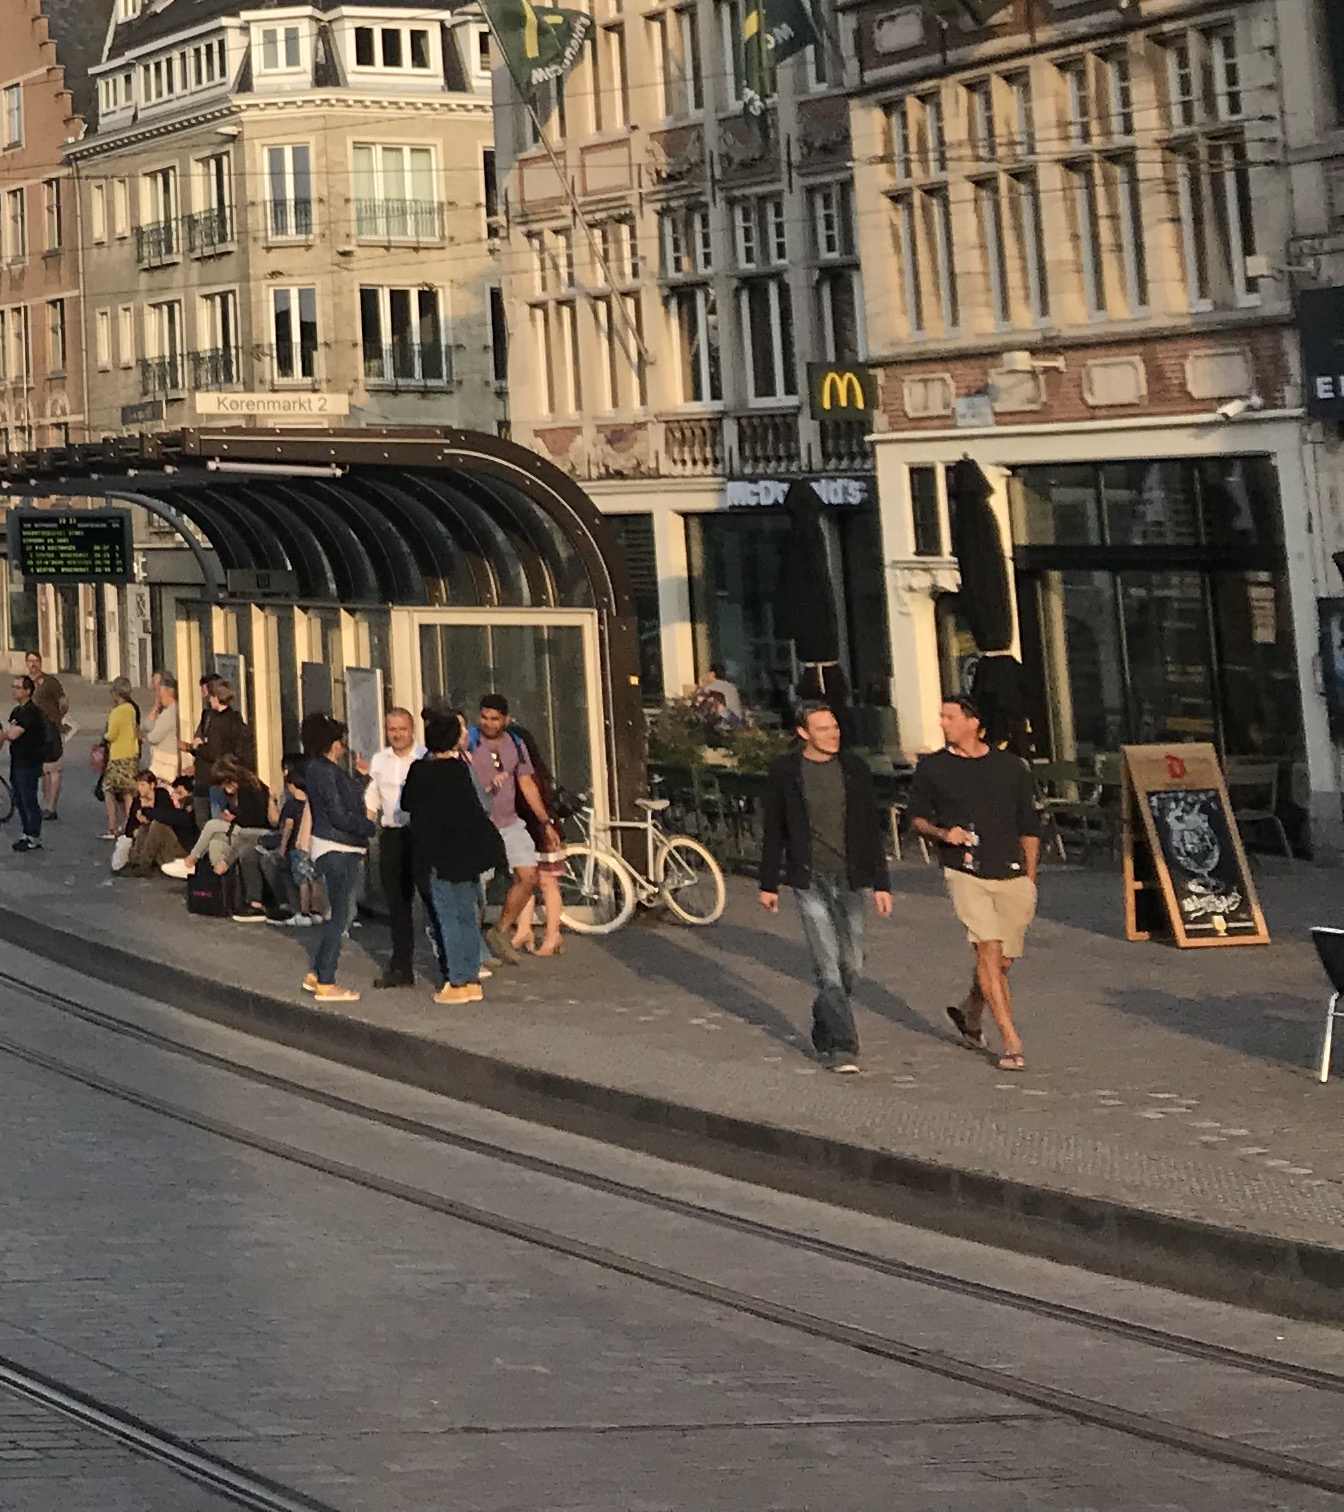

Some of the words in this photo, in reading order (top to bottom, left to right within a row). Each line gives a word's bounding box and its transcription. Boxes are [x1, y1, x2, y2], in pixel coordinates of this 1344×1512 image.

[217, 396, 312, 412] Korenmarkt
[317, 396, 328, 412] 2
[727, 478, 868, 506] McDld's
